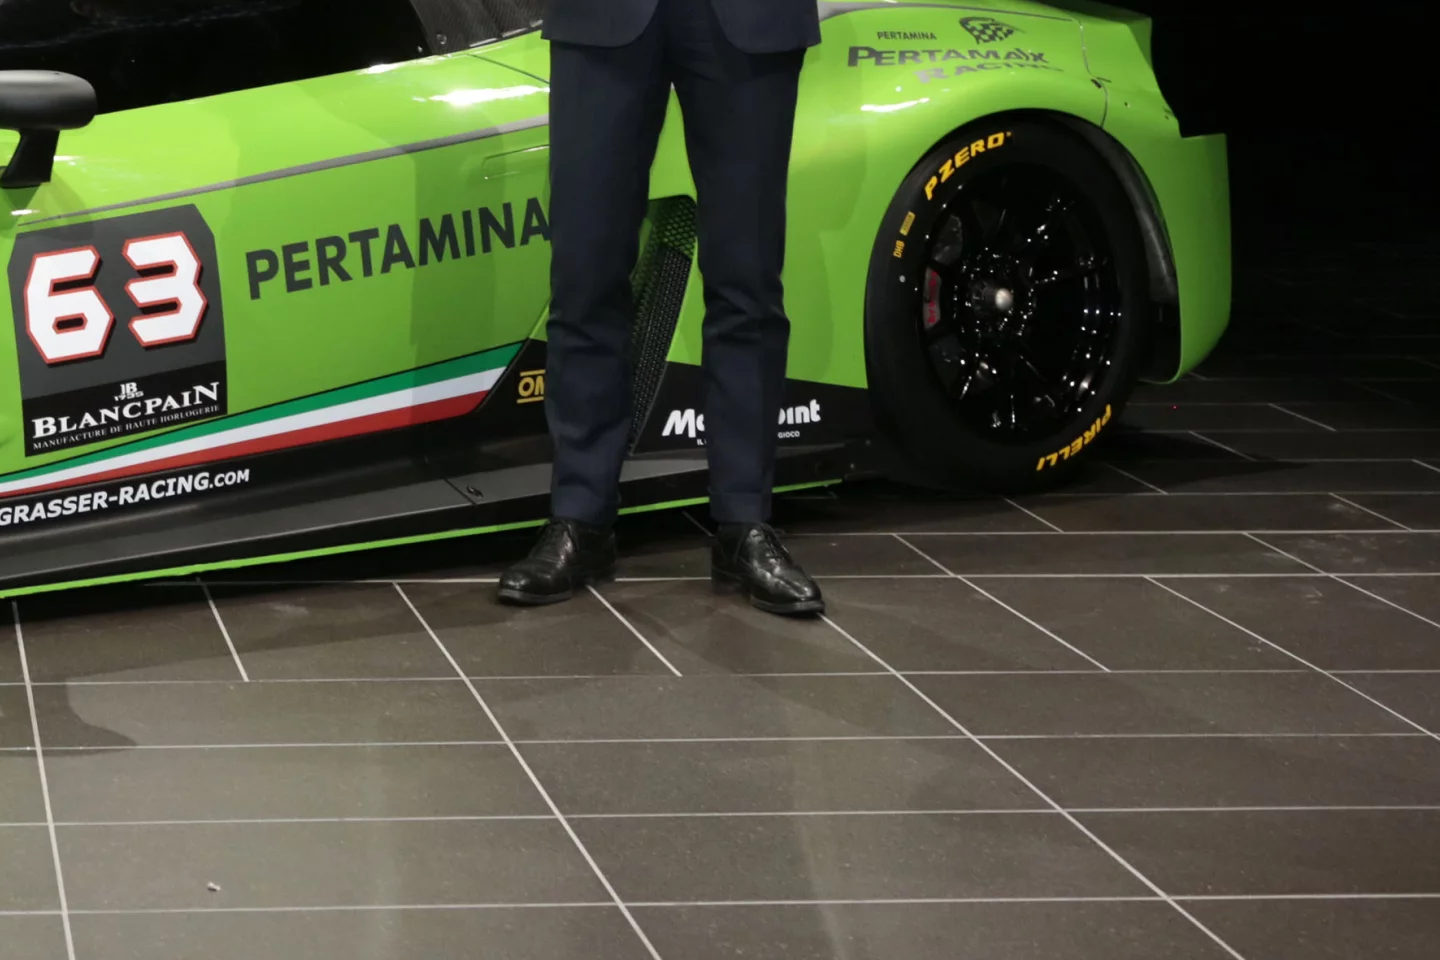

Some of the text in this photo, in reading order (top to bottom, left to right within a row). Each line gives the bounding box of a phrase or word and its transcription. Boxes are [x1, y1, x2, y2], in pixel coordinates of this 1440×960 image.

[876, 31, 938, 41] PERTAMINA
[245, 197, 551, 301] PERTAMINA
[23, 230, 208, 365] 63
[31, 382, 220, 439] BLANCPAIN
[32, 404, 220, 451] MANUFACTURE DE HAUTE HORLOGERIE
[1036, 403, 1112, 472] PIRELLI
